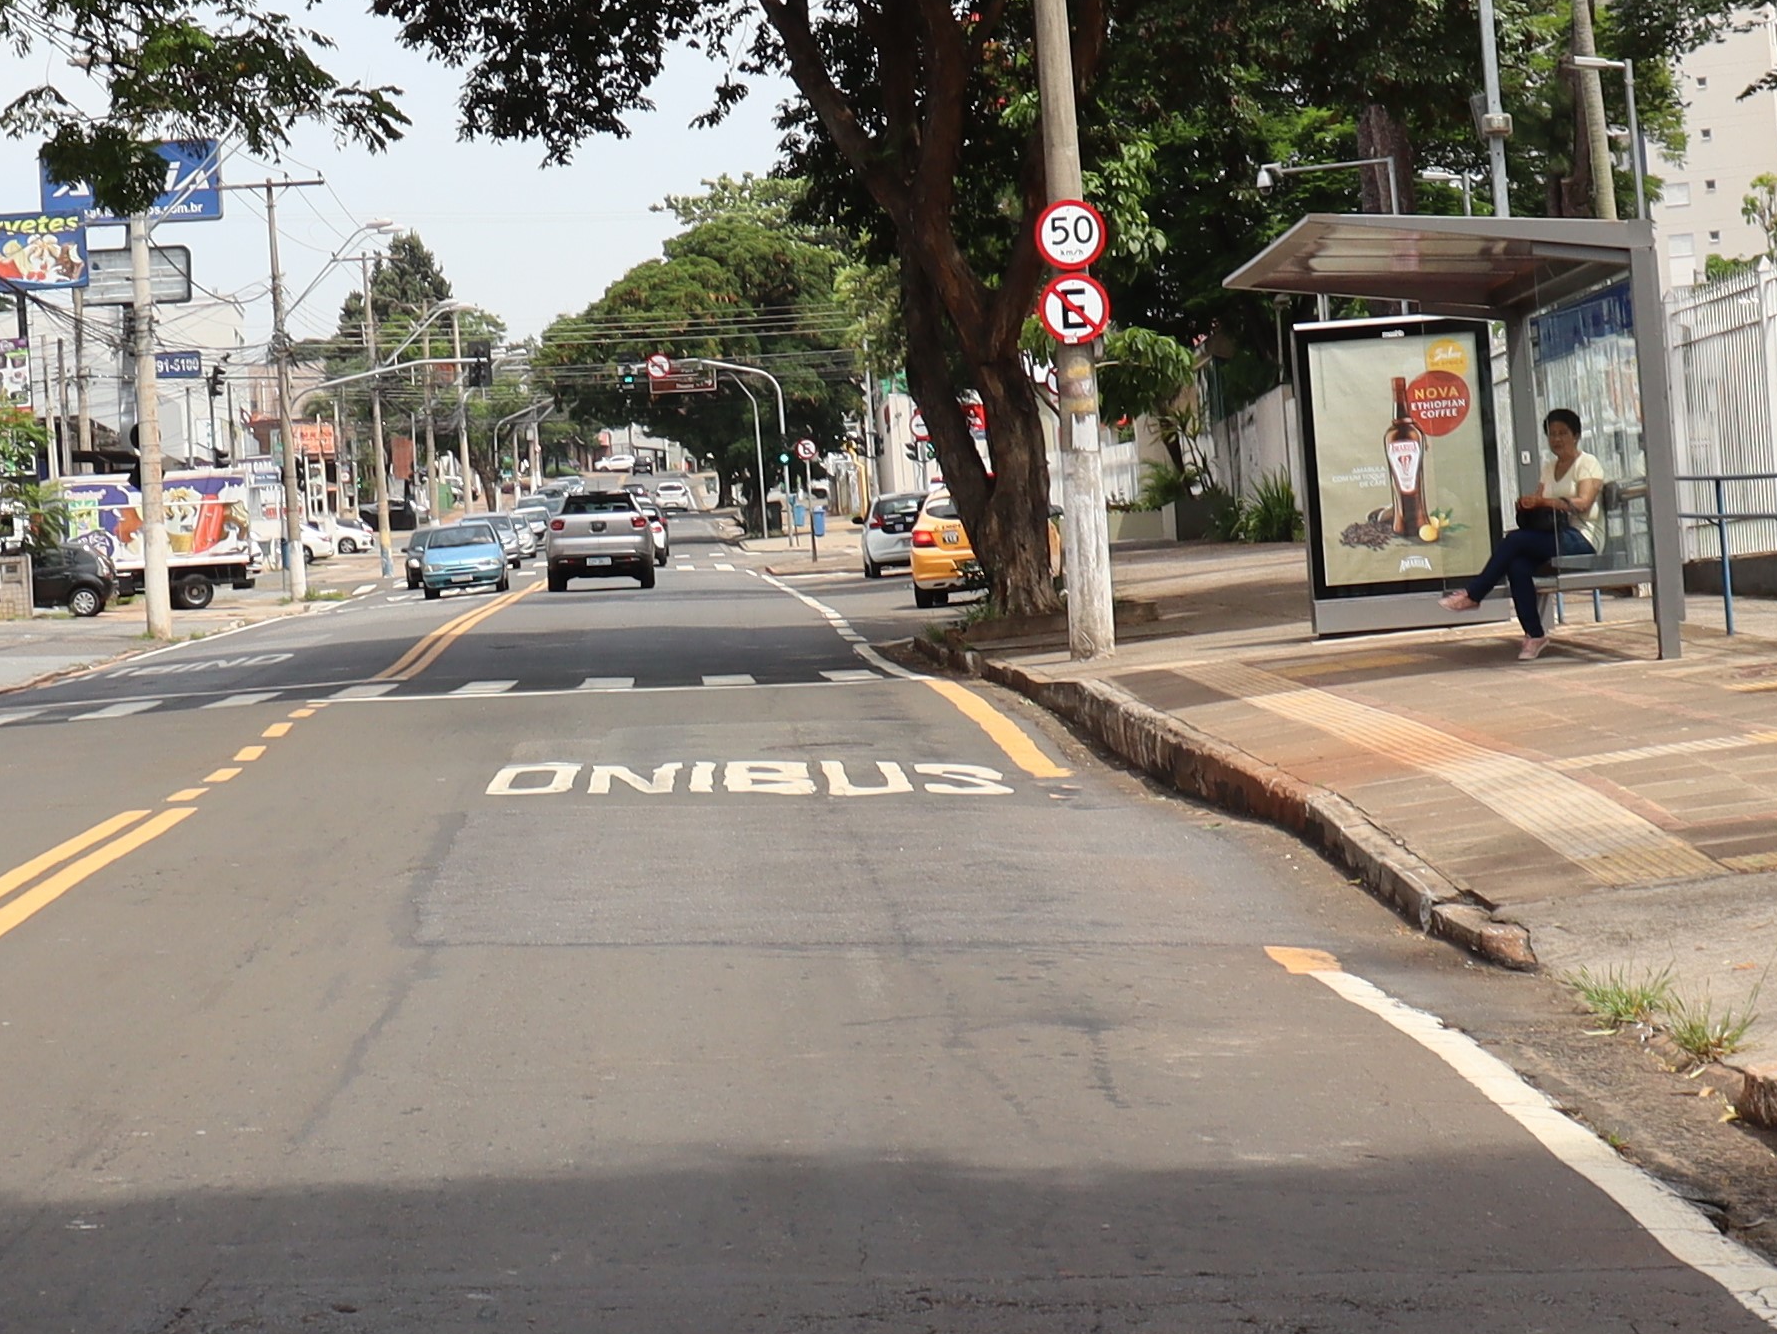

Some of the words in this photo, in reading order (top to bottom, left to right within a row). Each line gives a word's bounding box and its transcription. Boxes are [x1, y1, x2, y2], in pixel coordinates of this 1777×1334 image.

[1050, 215, 1094, 245] 50
[1060, 288, 1088, 329] E
[1414, 386, 1459, 400] NOVA
[1410, 398, 1466, 412] ETHIOPIAN
[1420, 408, 1458, 420] COFFEE
